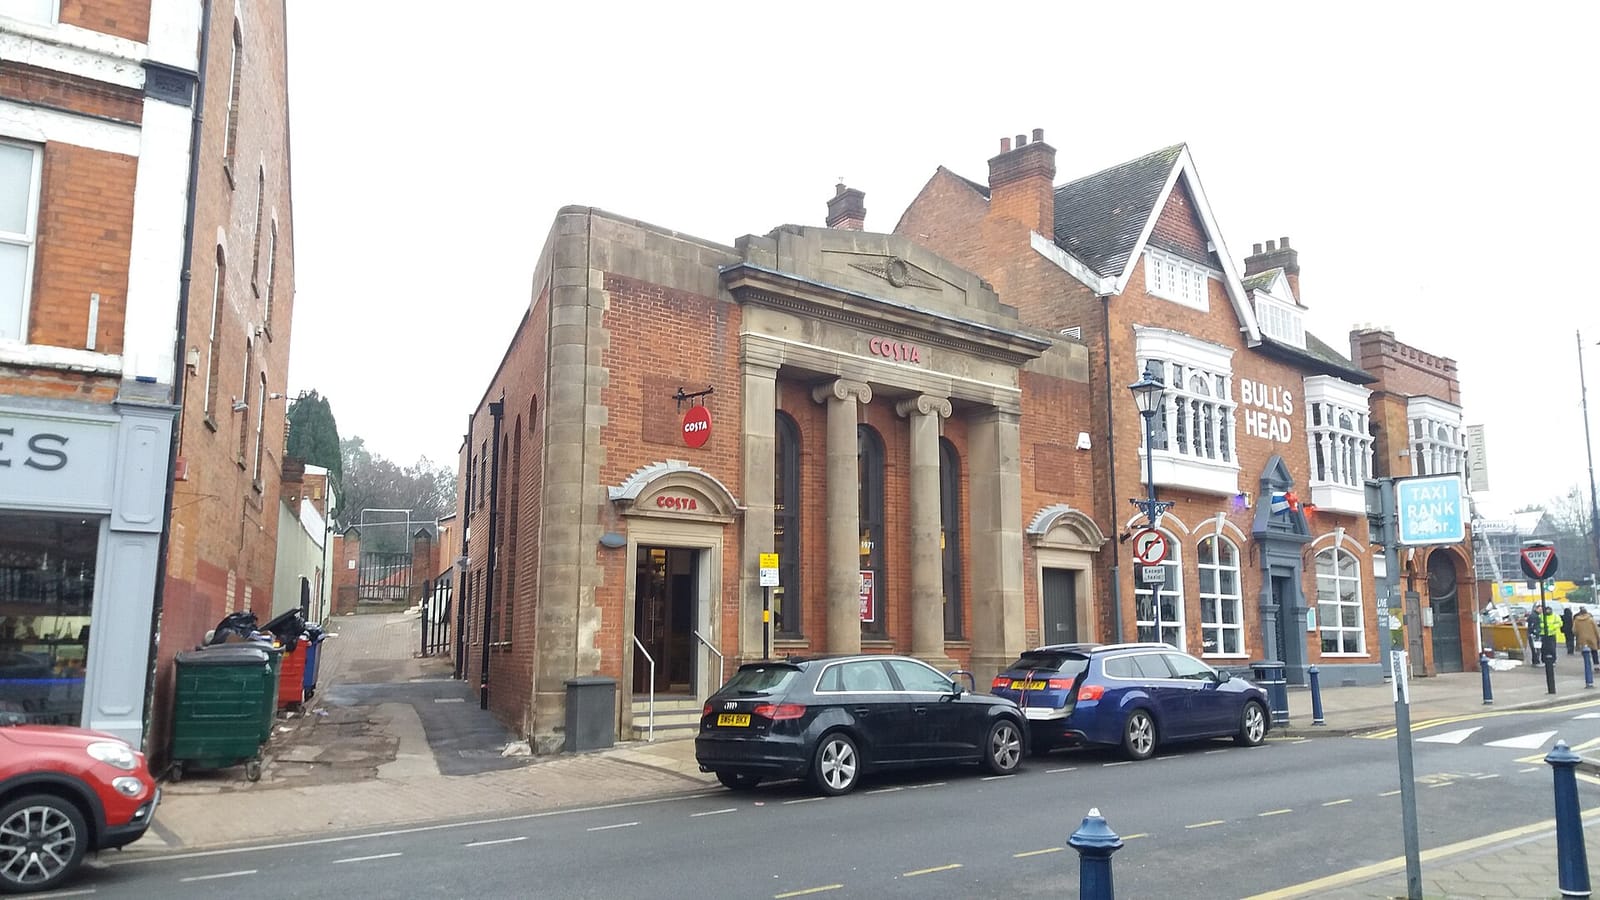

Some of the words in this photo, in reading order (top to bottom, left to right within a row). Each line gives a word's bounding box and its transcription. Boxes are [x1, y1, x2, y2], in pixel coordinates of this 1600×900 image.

[869, 336, 920, 363] COSTA
[1241, 378, 1293, 416] BULL'S
[684, 420, 708, 432] COSTA
[1245, 409, 1292, 443] HEAD
[1410, 485, 1447, 501] TAXI
[656, 496, 697, 510] COSTA
[1407, 502, 1455, 518] RANK
